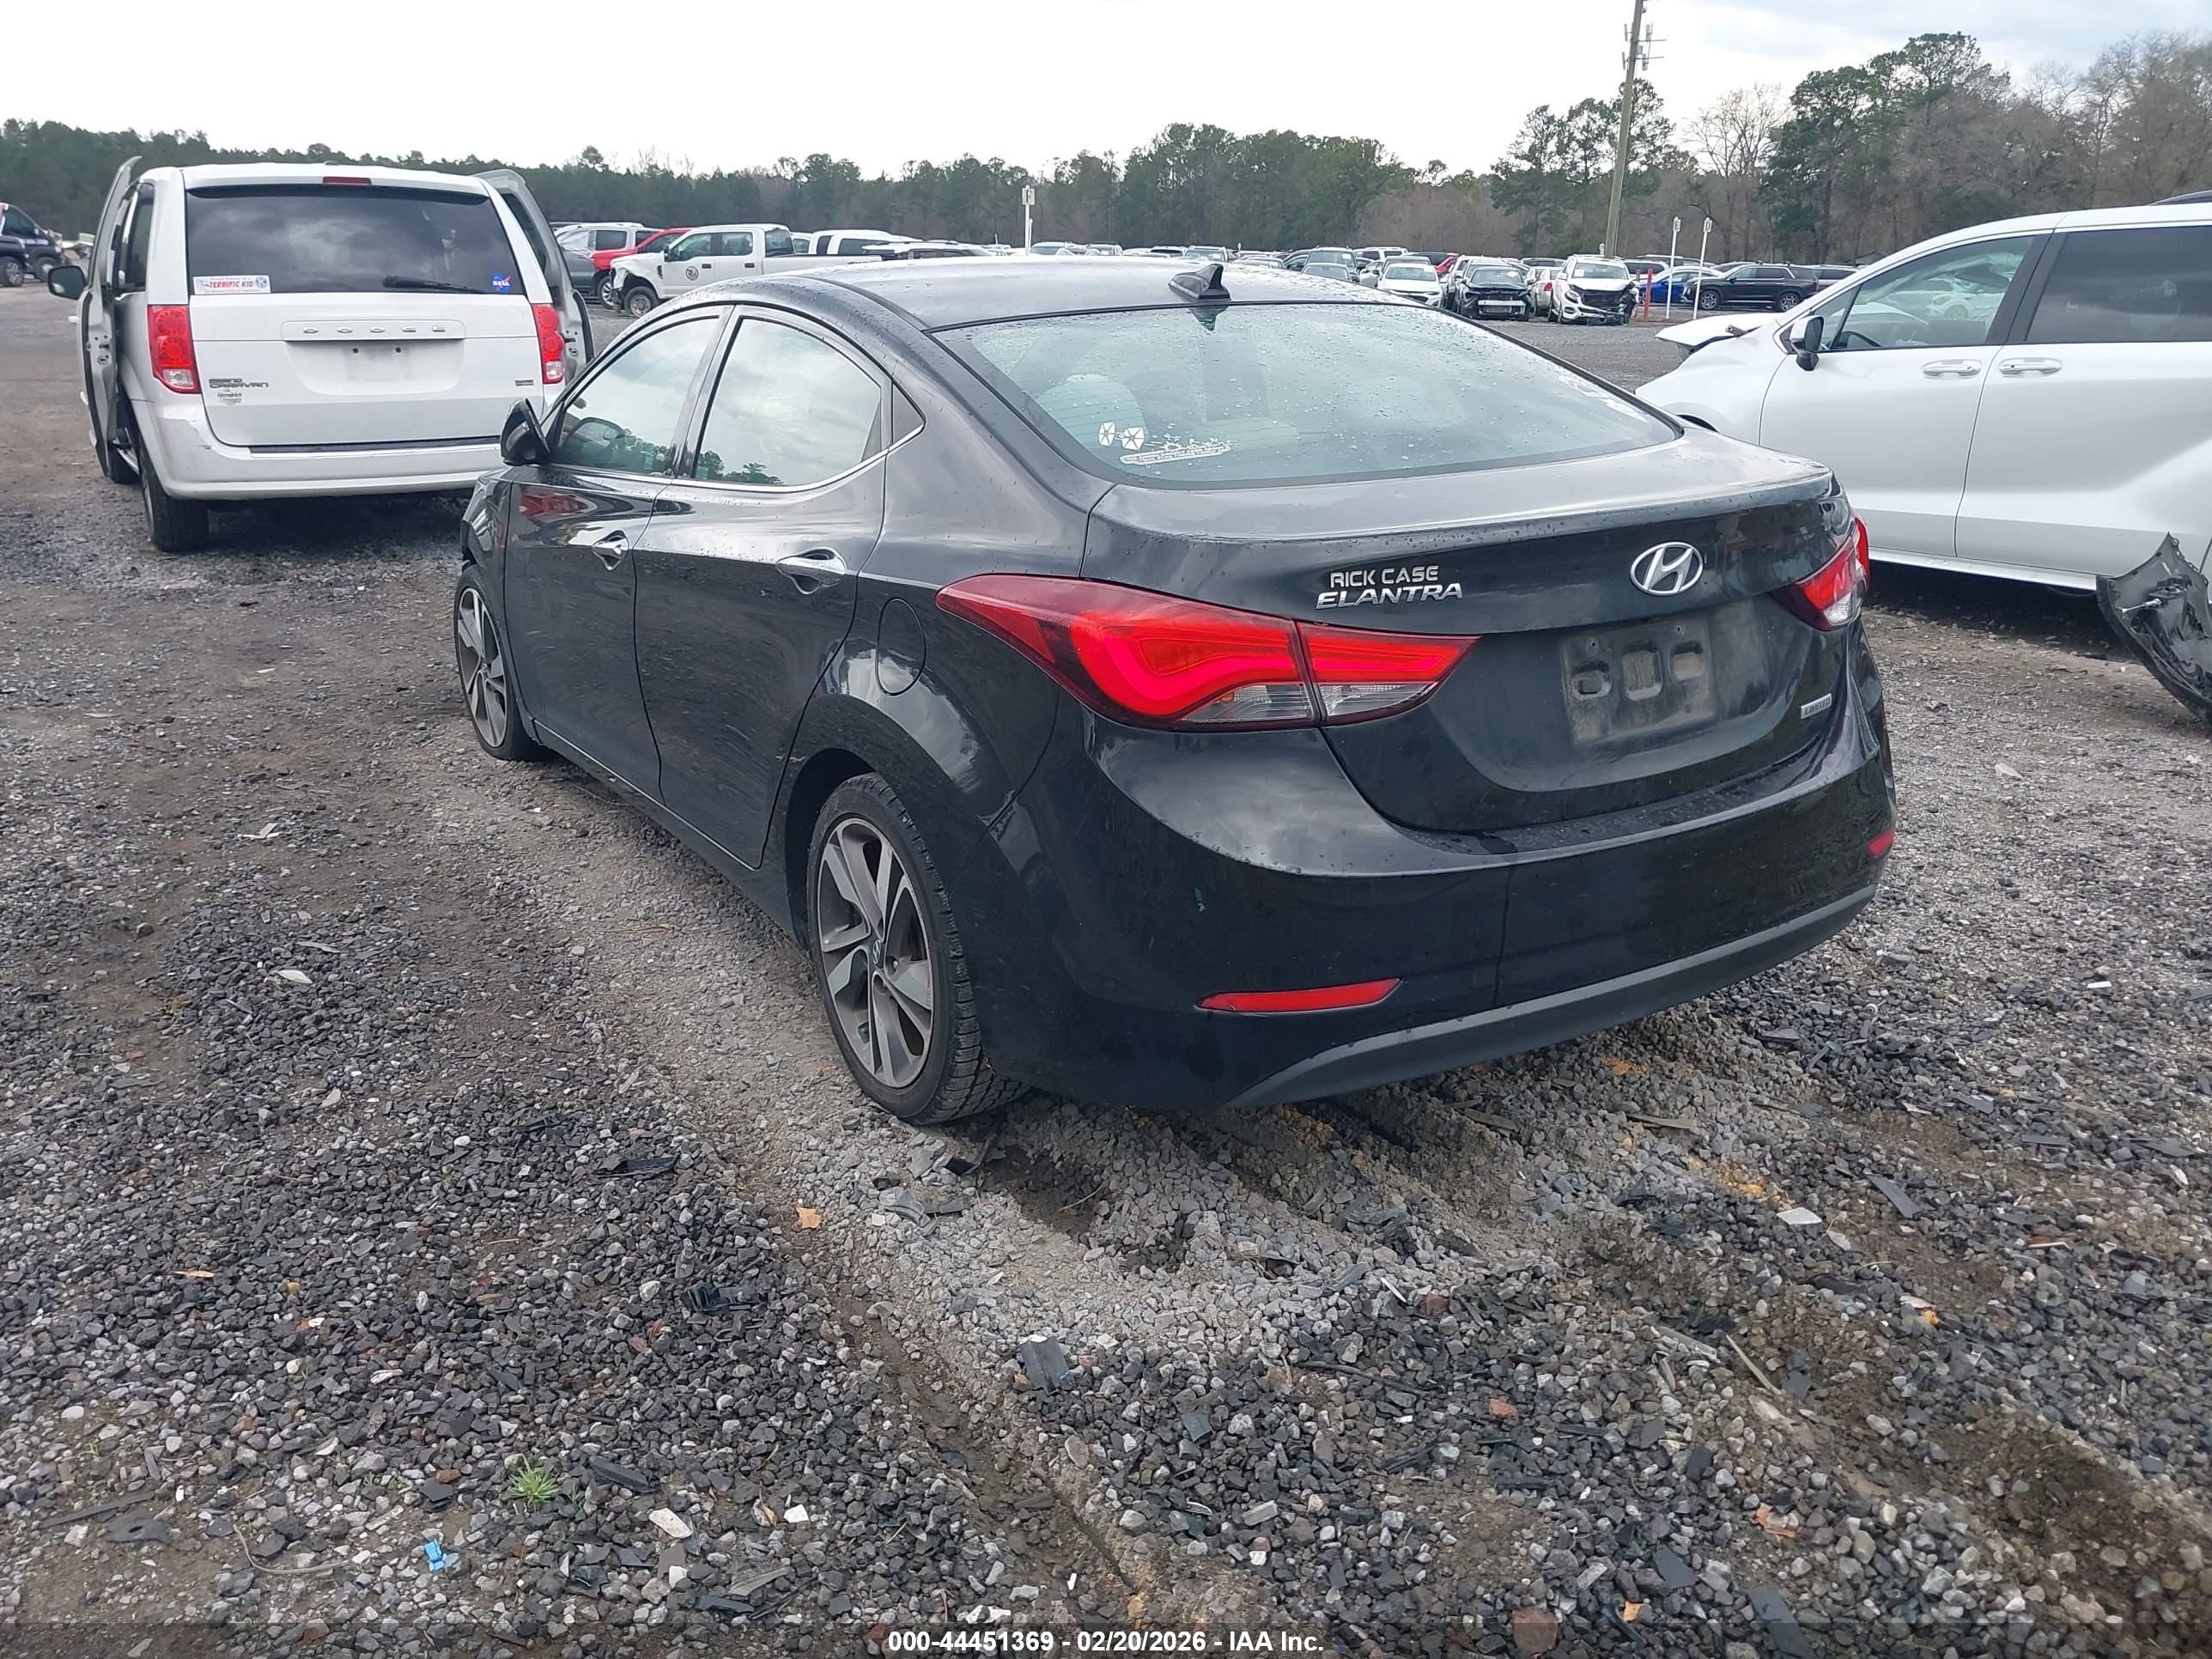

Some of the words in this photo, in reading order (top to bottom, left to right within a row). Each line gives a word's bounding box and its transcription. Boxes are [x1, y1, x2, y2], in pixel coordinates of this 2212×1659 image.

[1331, 570, 1376, 588] RICK
[1382, 565, 1439, 584] CASE
[1316, 582, 1463, 610] ELANTRA
[1804, 697, 1830, 715] LIMITED
